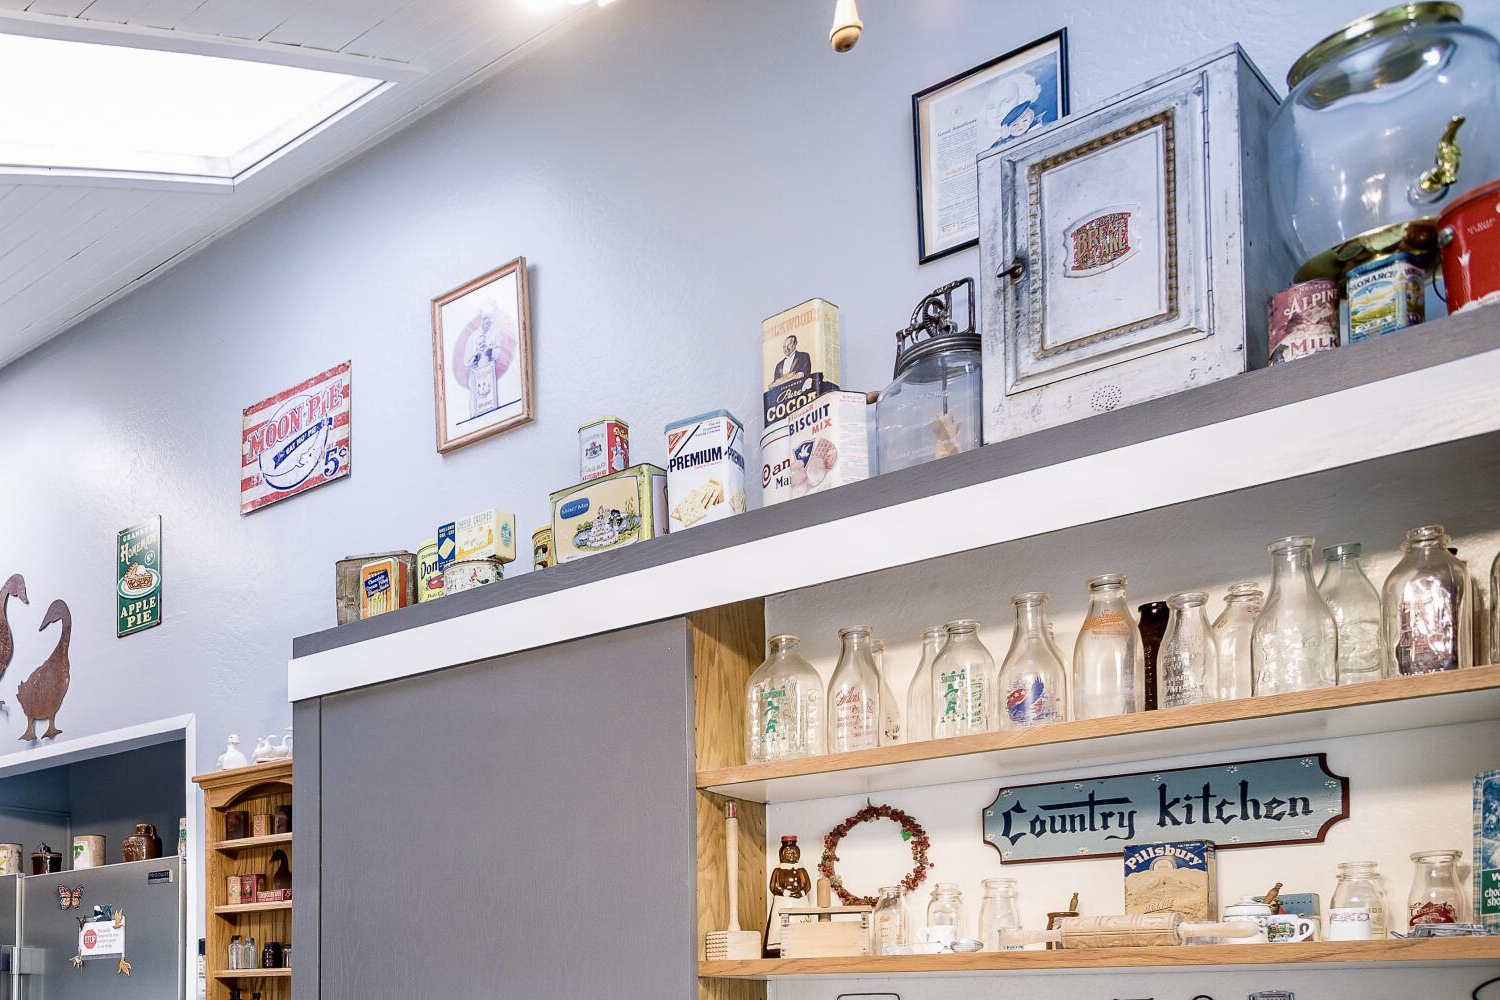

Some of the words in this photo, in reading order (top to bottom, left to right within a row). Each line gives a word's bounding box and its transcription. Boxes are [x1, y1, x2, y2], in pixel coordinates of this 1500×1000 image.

[1290, 337, 1339, 356] MILK
[767, 391, 817, 422] COCOA
[249, 406, 303, 461] MOON
[306, 379, 343, 425] PIE
[789, 404, 831, 436] BISCUIT
[811, 418, 833, 436] MIX
[669, 446, 722, 472] PREMIUM
[120, 596, 156, 618] APPLE
[127, 610, 152, 628] PIE
[1001, 789, 1137, 847] Country
[1156, 779, 1314, 829] kitchen
[1125, 844, 1203, 870] Pillsbury
[85, 935, 96, 944] STOP
